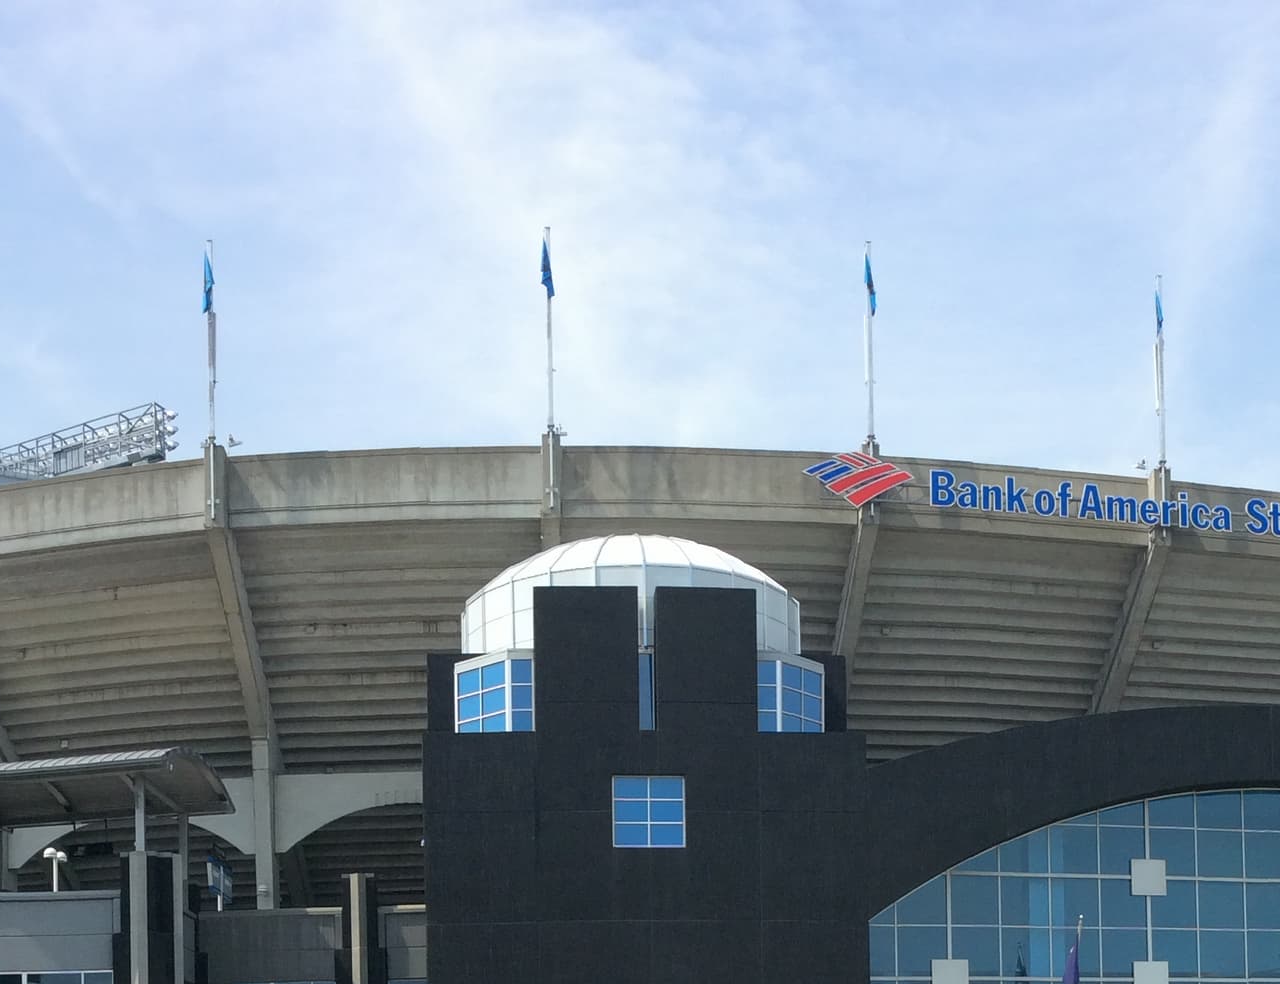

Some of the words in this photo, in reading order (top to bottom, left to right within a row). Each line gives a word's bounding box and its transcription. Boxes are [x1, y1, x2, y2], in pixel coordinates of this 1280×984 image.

[929, 469, 1027, 514] Bank
[1033, 480, 1072, 517] of
[1077, 483, 1233, 533] America
